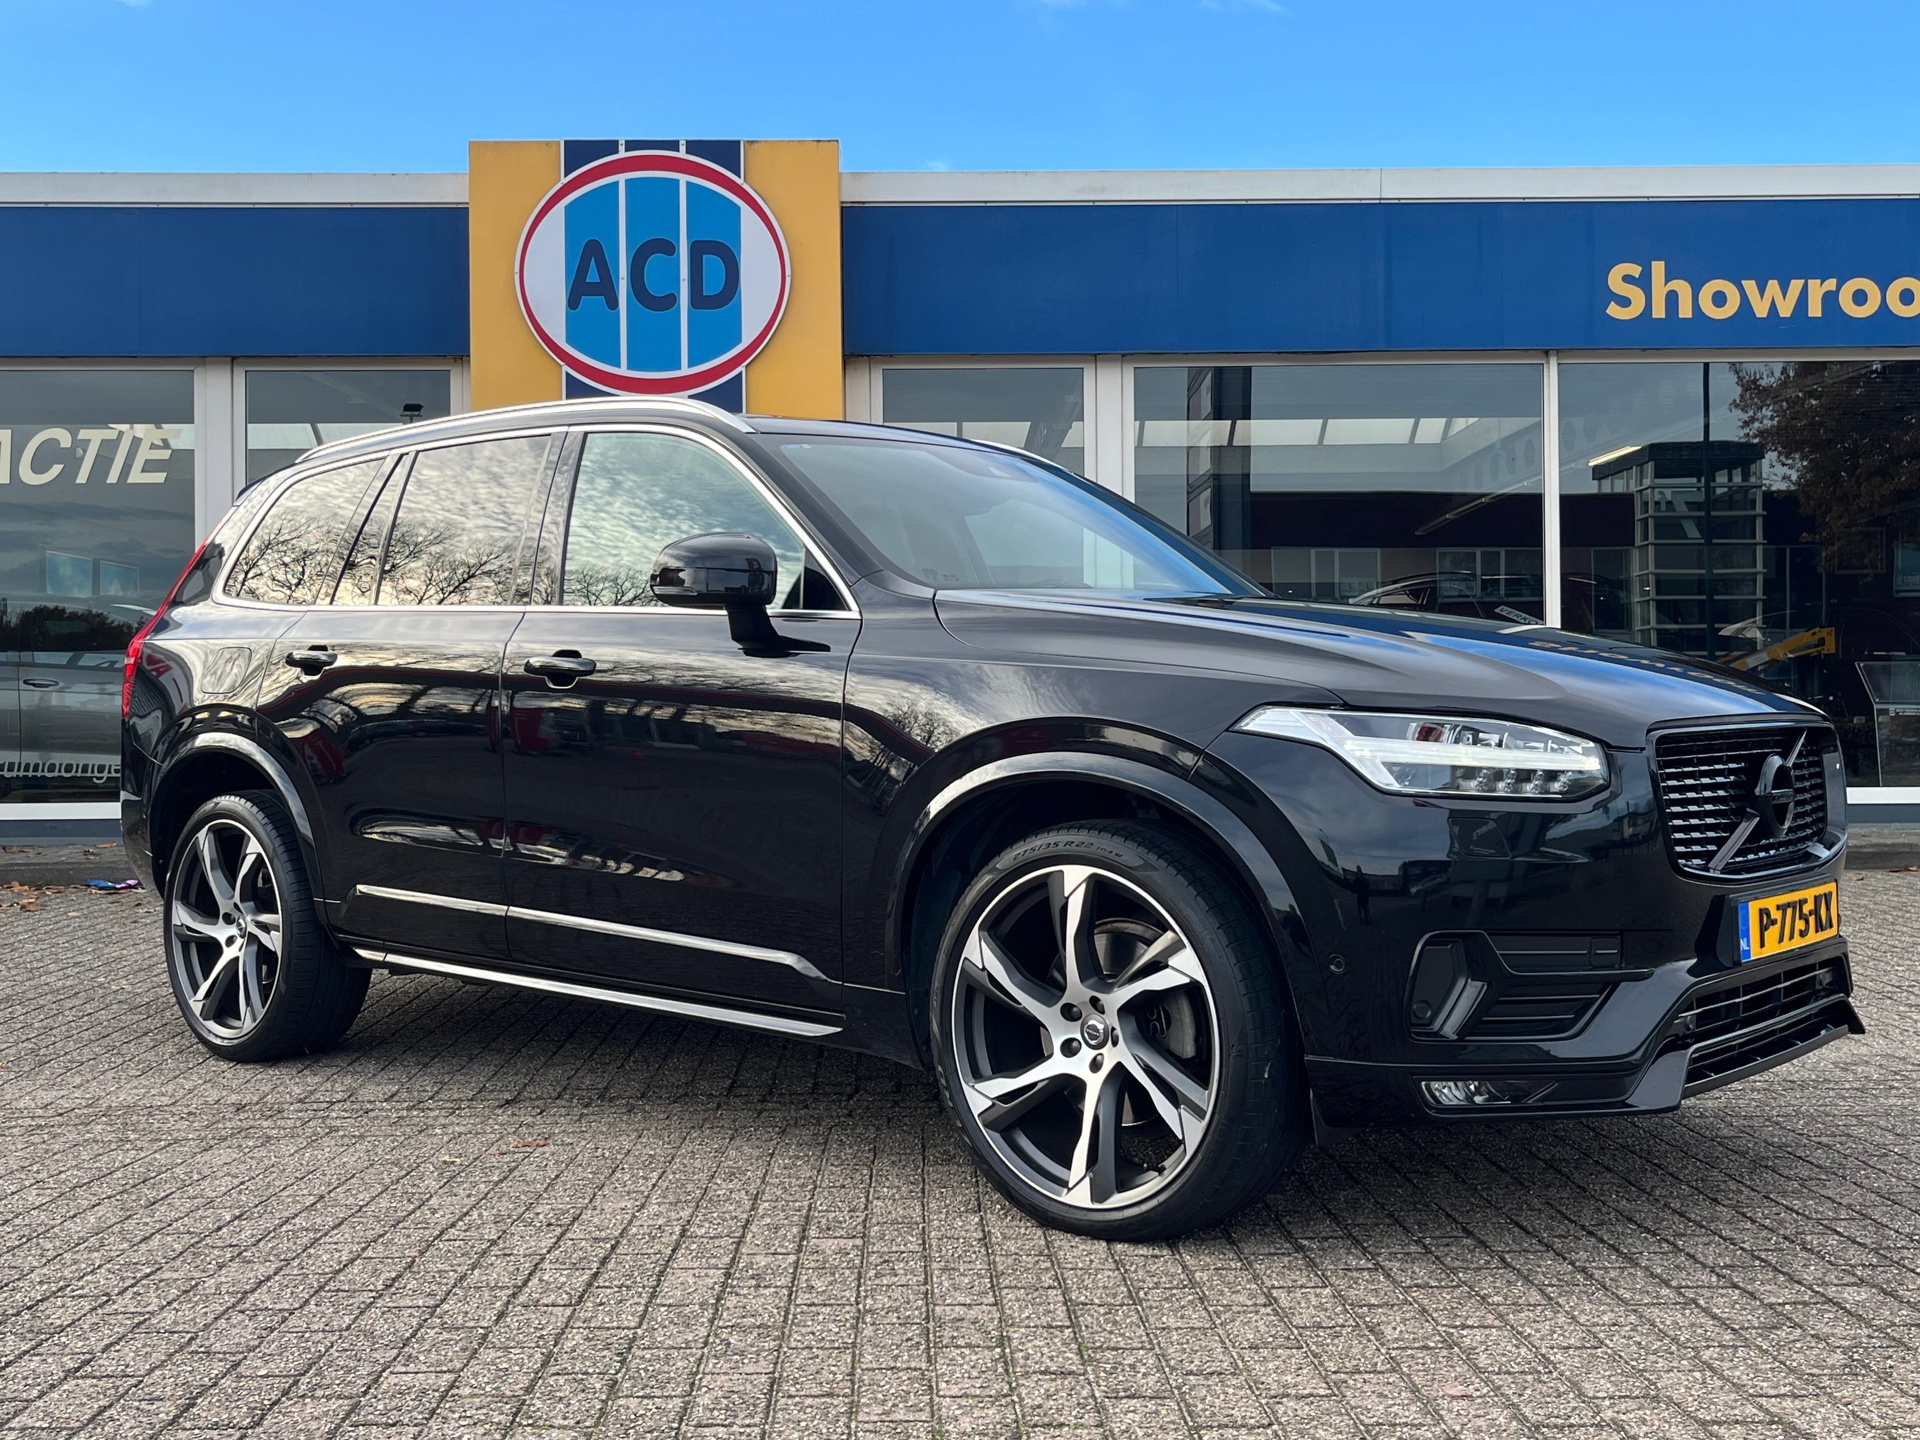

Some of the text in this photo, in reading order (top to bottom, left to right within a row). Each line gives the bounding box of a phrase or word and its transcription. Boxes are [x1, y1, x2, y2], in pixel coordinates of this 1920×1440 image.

[567, 237, 740, 312] ACD
[1605, 260, 1920, 320] Showroo
[0, 427, 182, 486] CTIE
[1012, 841, 1062, 862] 275/35
[1740, 937, 1750, 952] NL
[1758, 891, 1834, 950] P-775-KX
